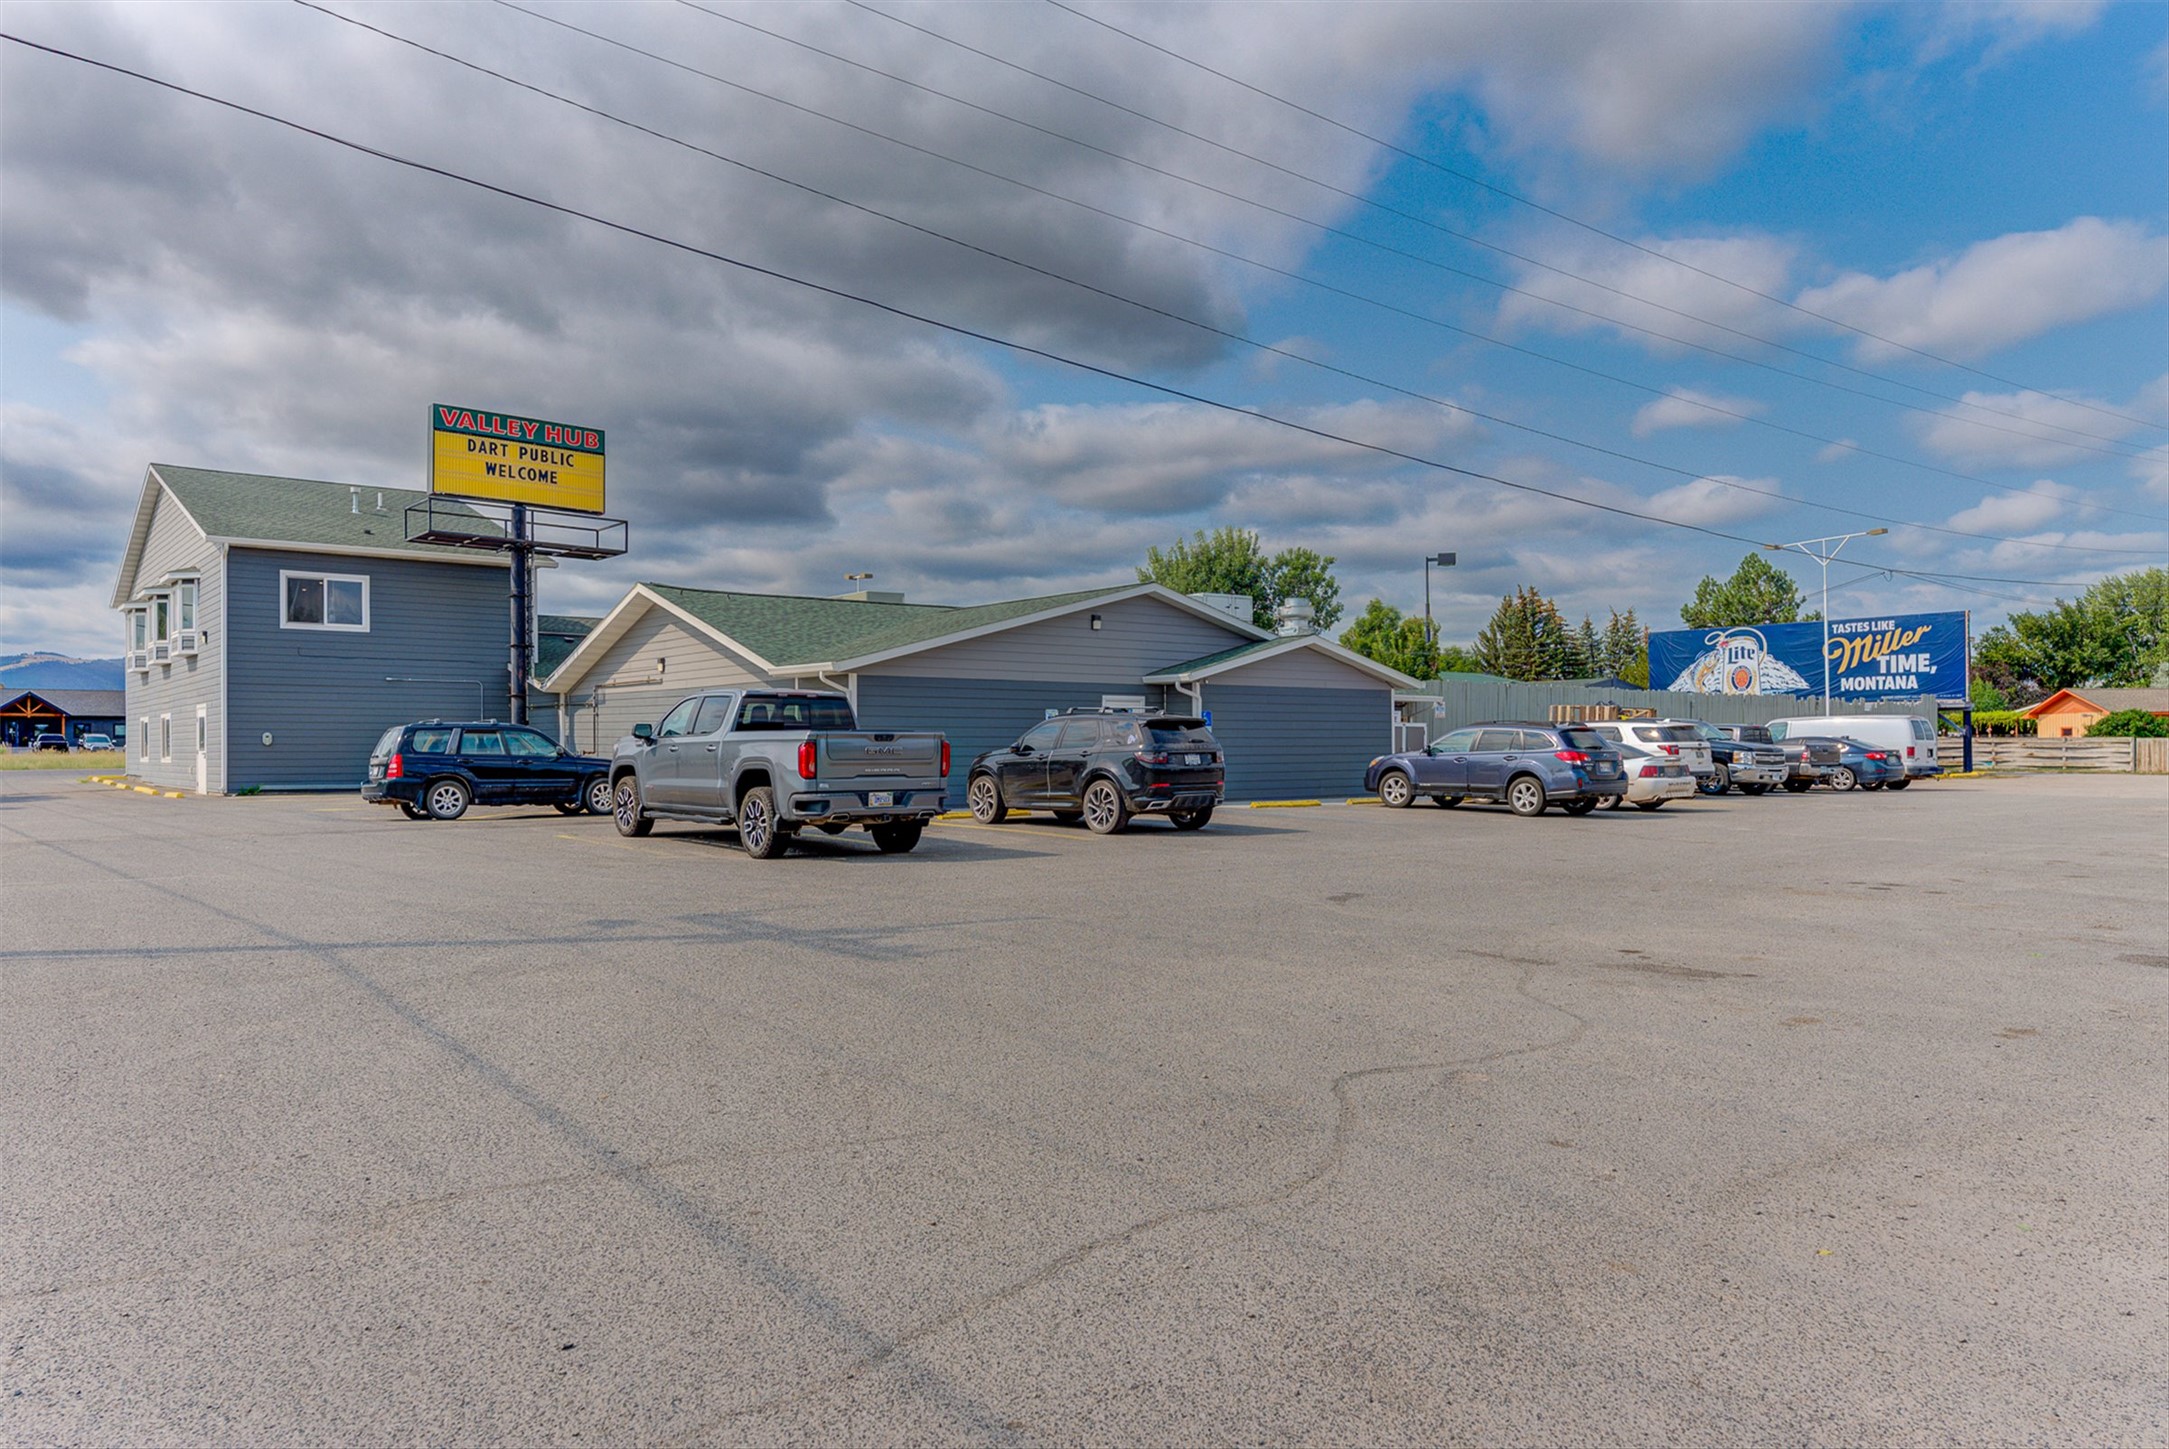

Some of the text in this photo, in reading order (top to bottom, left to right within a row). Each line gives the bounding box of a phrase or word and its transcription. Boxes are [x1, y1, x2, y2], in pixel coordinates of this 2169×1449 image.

[440, 408, 599, 448] VALLEY HUB
[467, 438, 575, 467] DART PUBLIC
[485, 461, 558, 485] WELCOME
[1832, 620, 1896, 634] TASTES LIKE
[1727, 646, 1756, 665] Lite
[1822, 625, 1932, 674] Miller
[1876, 653, 1938, 675] TIME,
[1840, 675, 1919, 692] MONTANA
[864, 746, 903, 756] GMC
